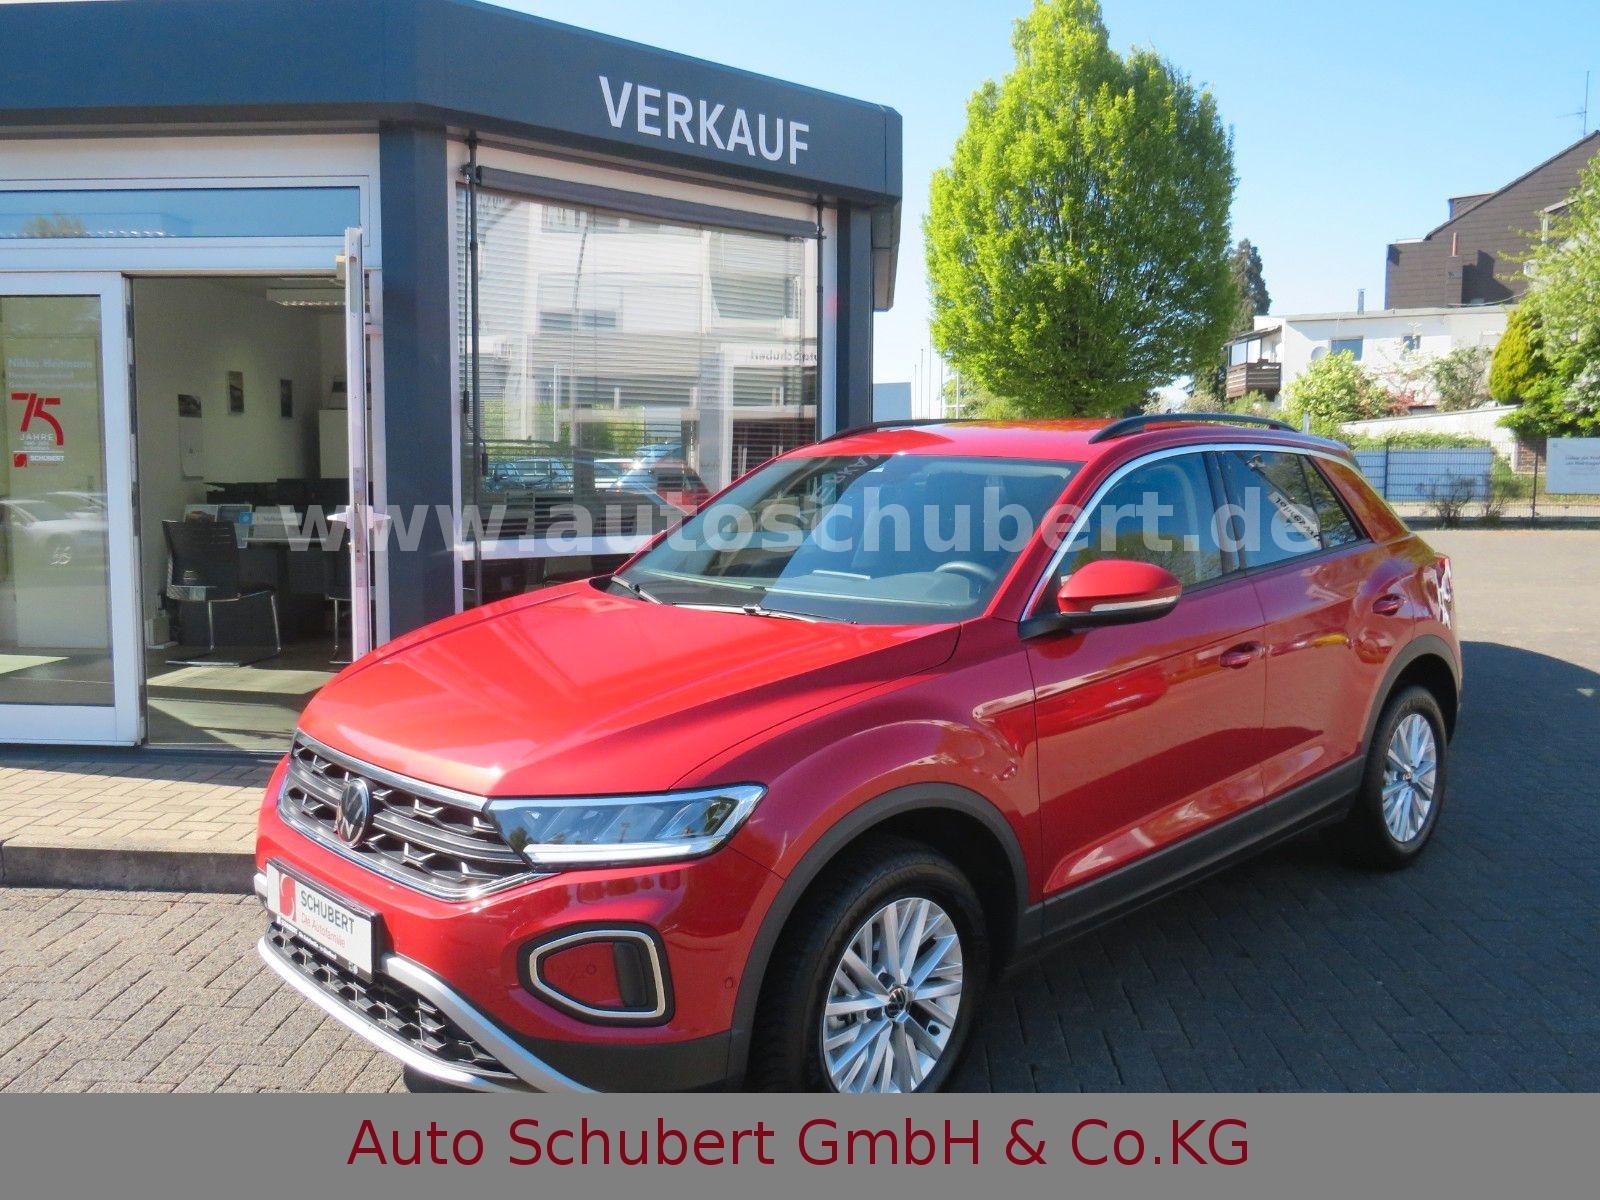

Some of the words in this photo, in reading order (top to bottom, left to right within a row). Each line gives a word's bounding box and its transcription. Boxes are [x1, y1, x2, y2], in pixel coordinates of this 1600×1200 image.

[599, 75, 810, 165] VERKAUF
[11, 393, 64, 446] 75
[20, 433, 54, 441] JAHRE
[300, 890, 355, 934] SCHUBERT
